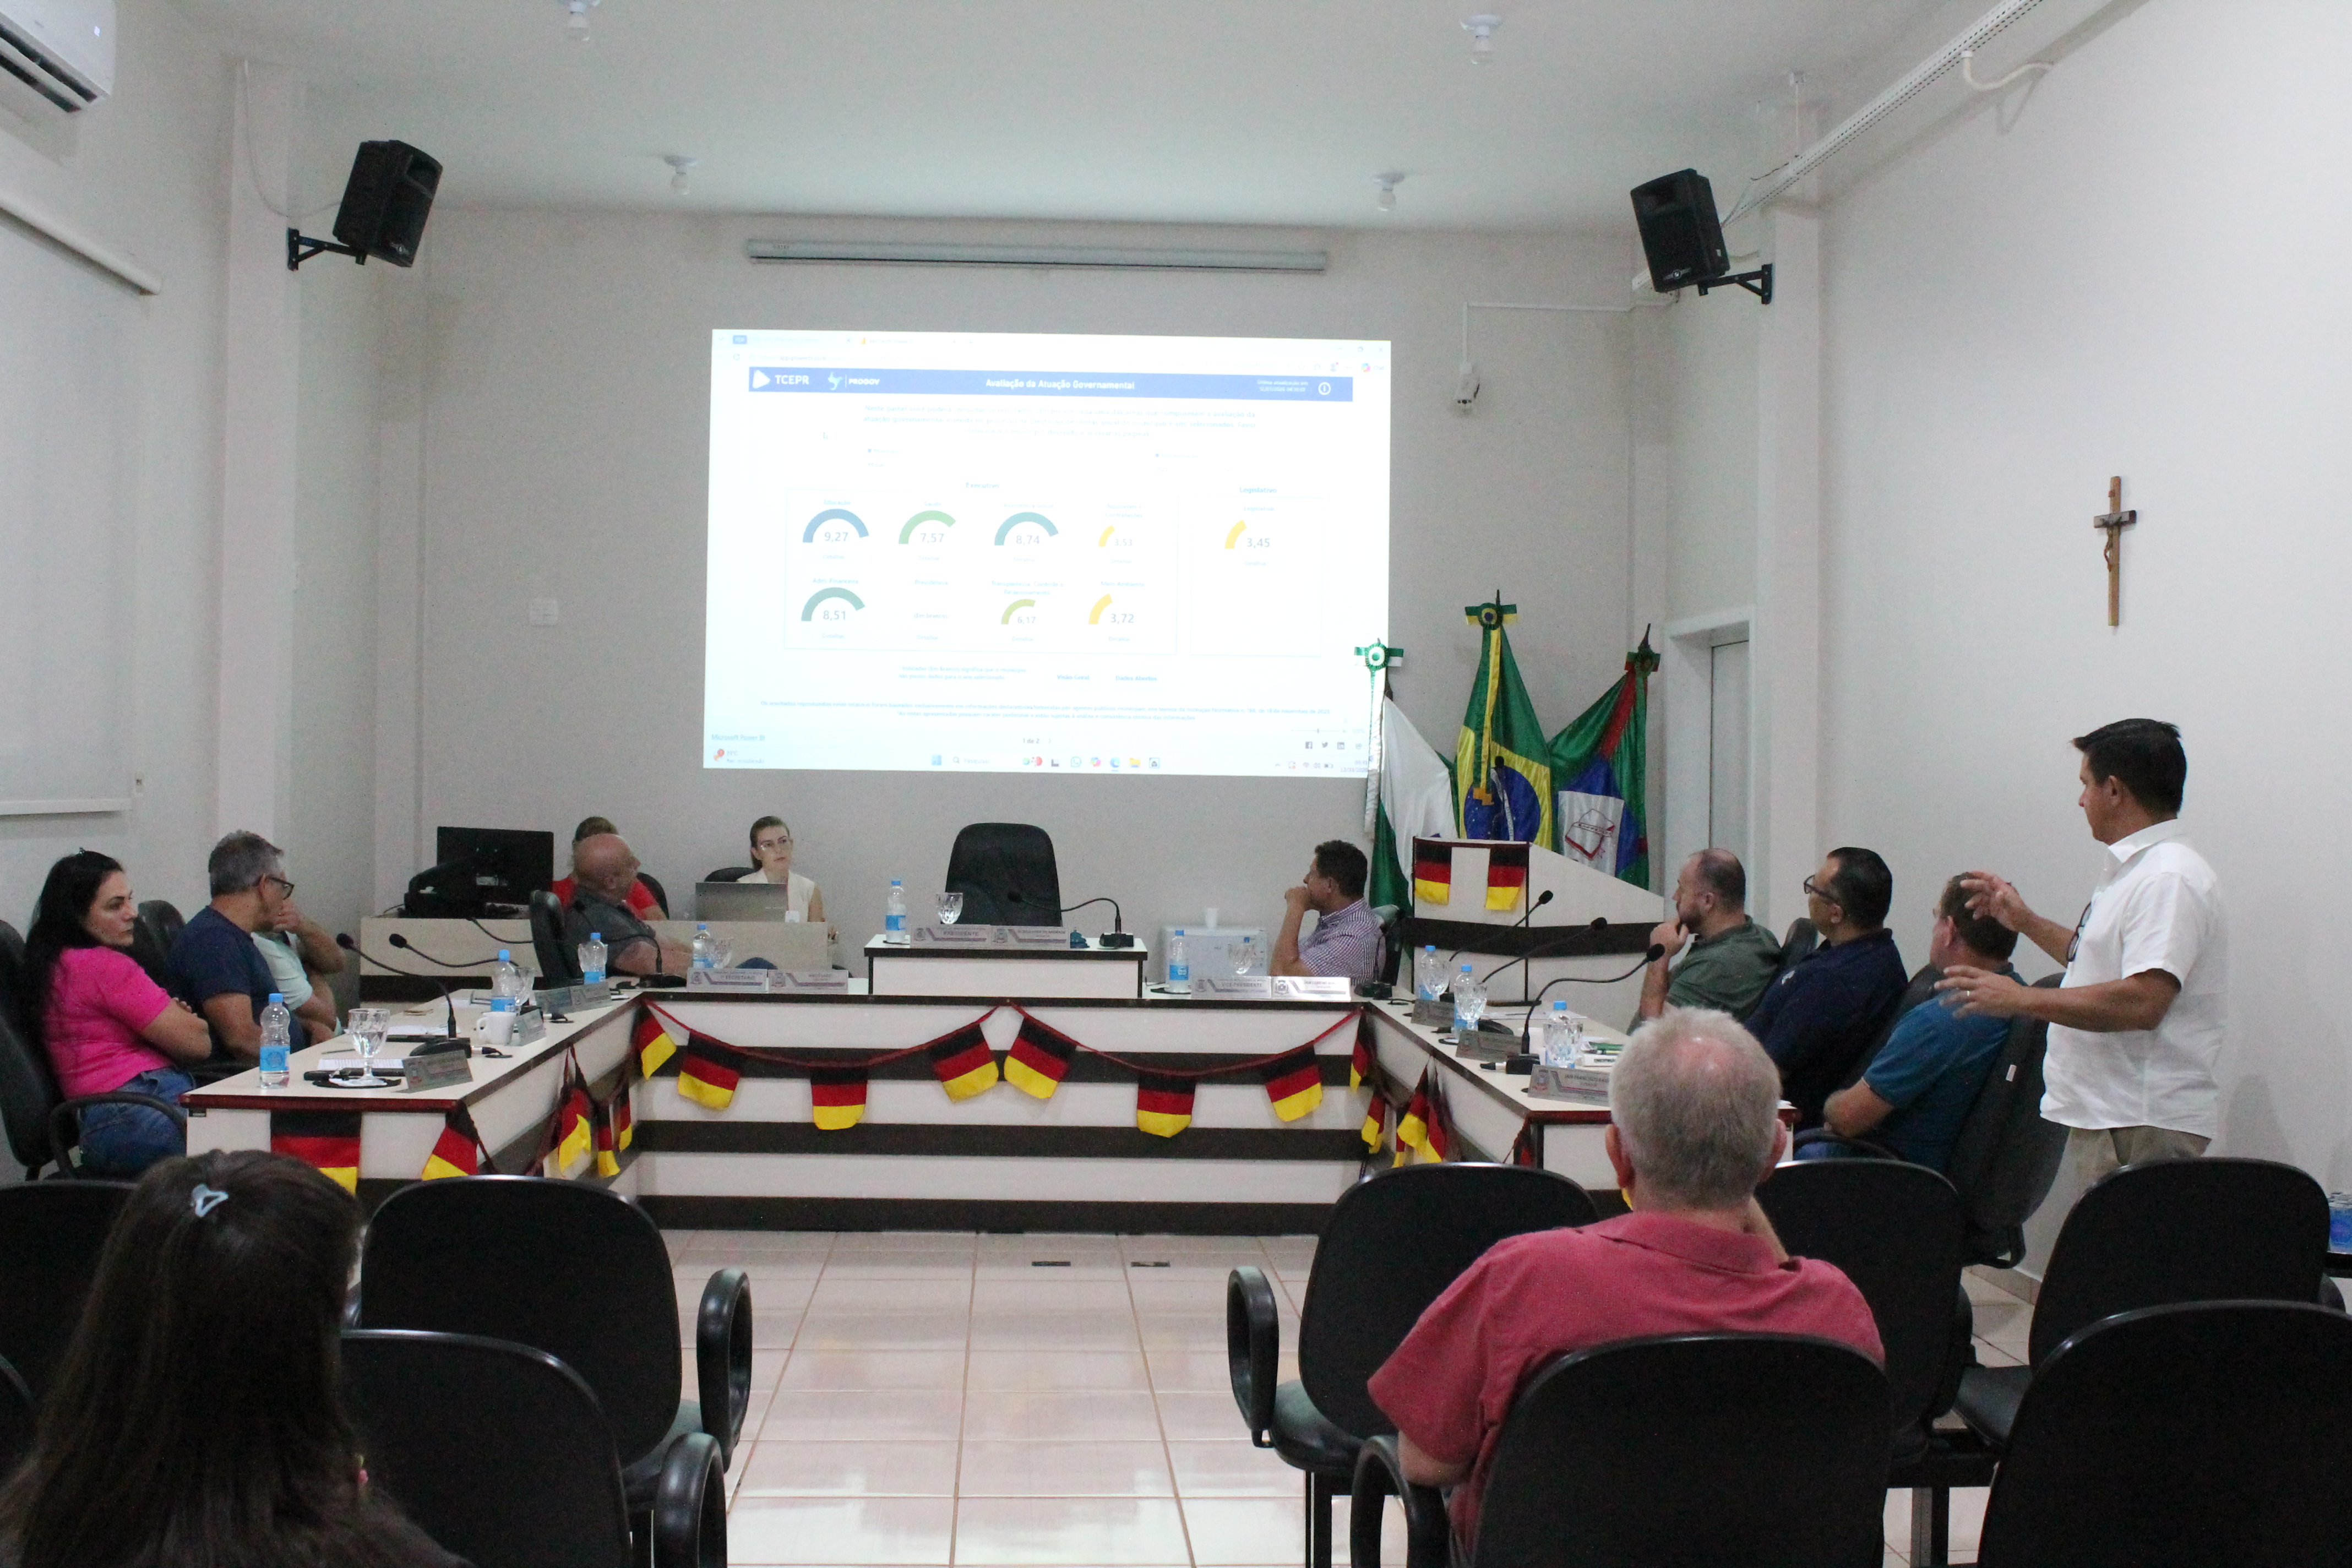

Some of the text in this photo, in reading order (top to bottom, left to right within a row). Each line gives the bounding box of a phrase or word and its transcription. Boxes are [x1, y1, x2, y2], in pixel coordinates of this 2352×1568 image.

[774, 374, 809, 385] TCEPR
[986, 378, 1135, 390] Avaliação da Atuação Governamental
[1213, 410, 1245, 418] avaliação
[892, 416, 945, 424] governamental
[824, 532, 849, 544] 9,27
[920, 532, 945, 544] 7,57
[1015, 535, 1040, 546] 8,74
[1114, 538, 1133, 547] 3,53
[1246, 537, 1271, 549] 3,45
[823, 610, 847, 622] 8,51
[1017, 616, 1036, 625] 6,17
[1110, 613, 1135, 624] 3,72
